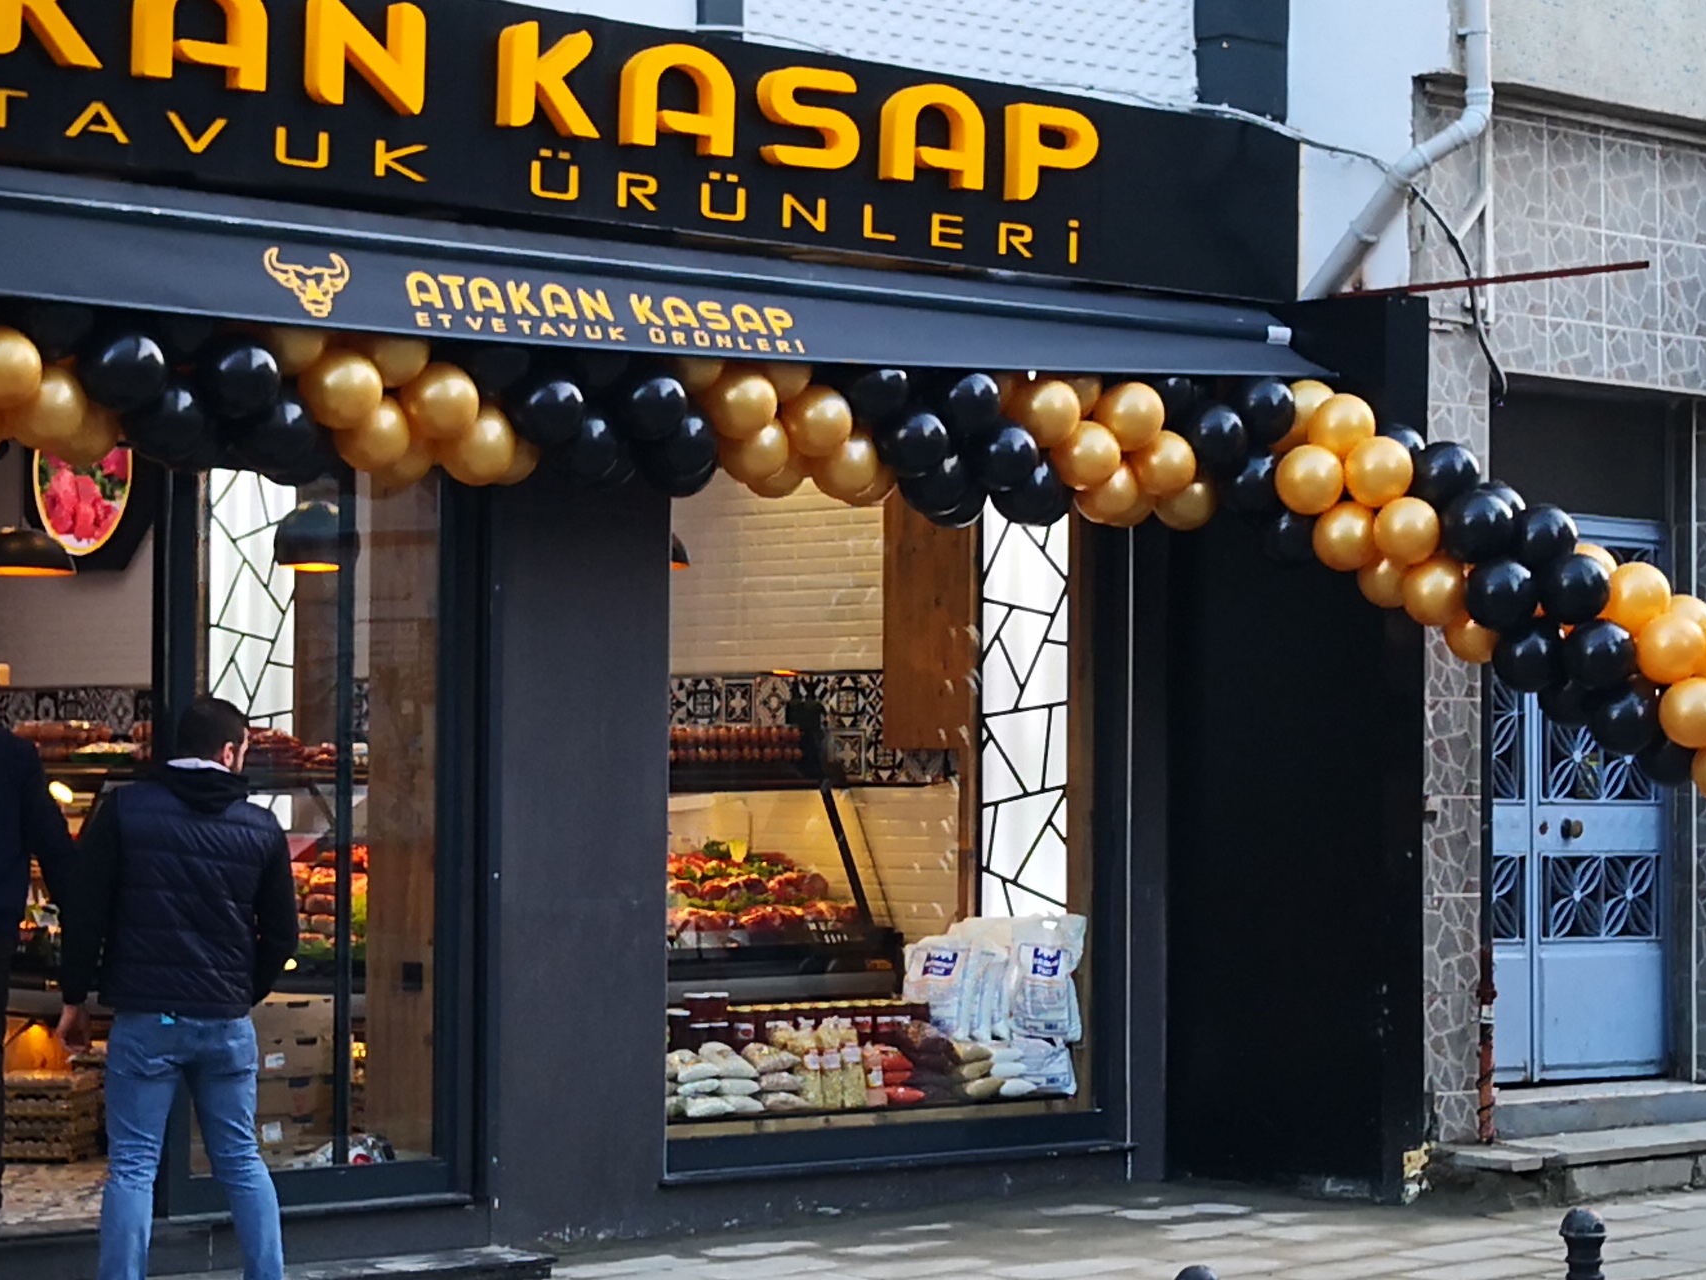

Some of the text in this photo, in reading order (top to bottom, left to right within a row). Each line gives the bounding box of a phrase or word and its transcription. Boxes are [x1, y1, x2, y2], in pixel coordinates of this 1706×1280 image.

[495, 20, 1099, 202] KASAP
[529, 149, 1079, 265] ÜRÜNLERİ
[405, 270, 794, 338] ATAKAN KASAP
[414, 311, 454, 329] ET
[465, 317, 507, 333] VE
[518, 320, 628, 343] TAVUK
